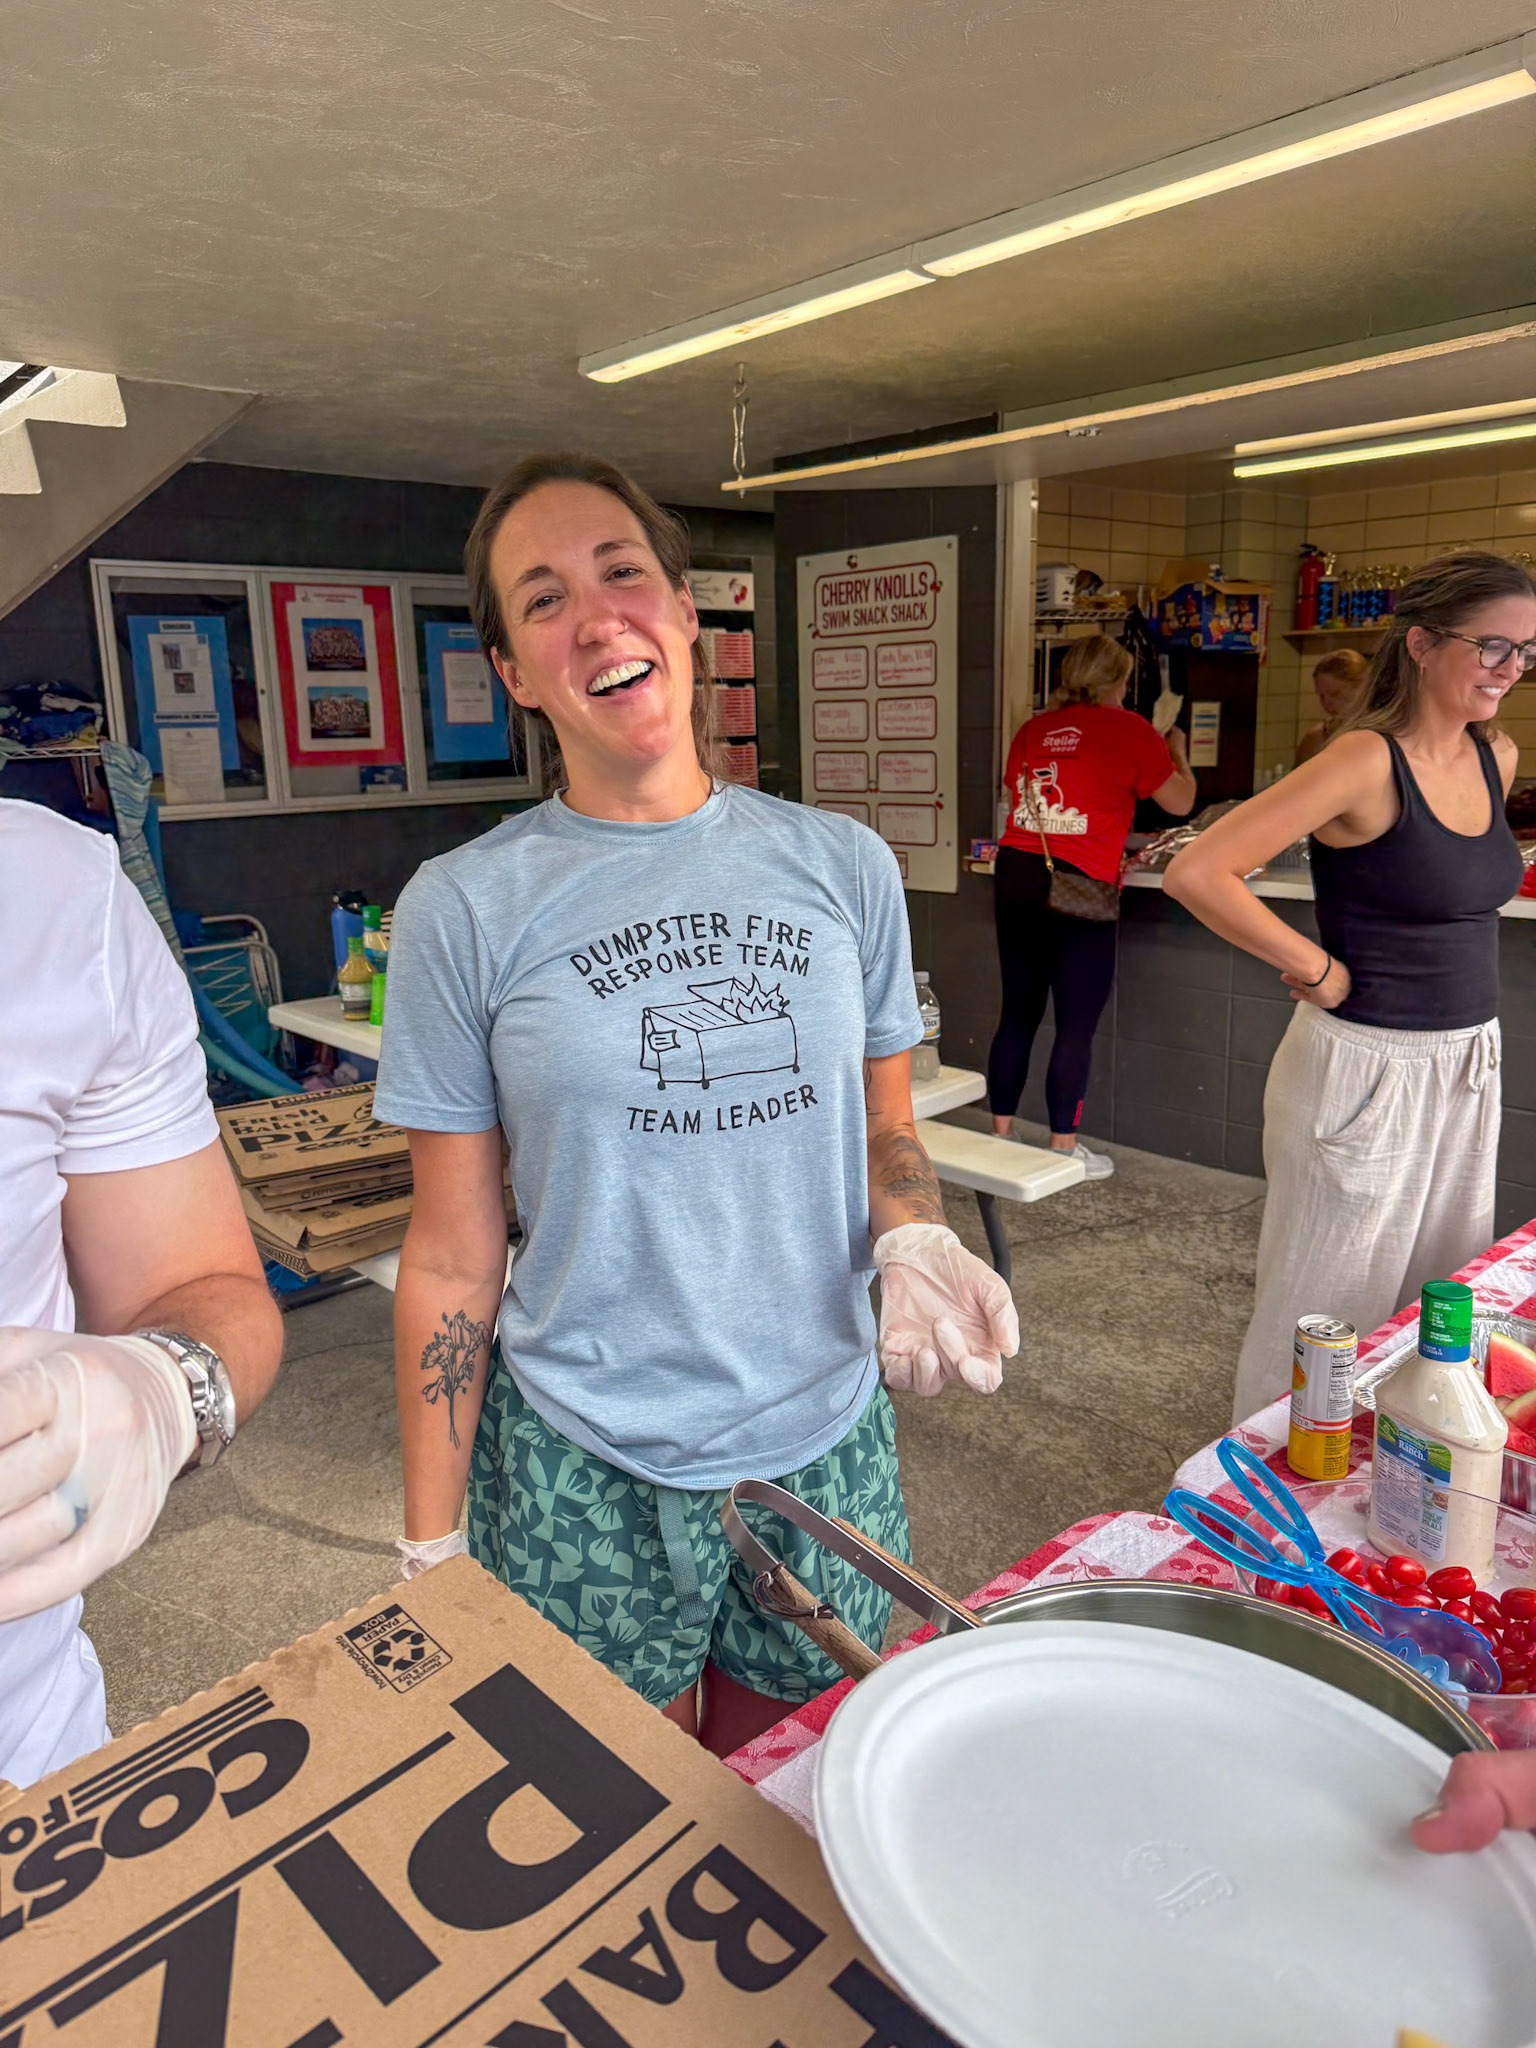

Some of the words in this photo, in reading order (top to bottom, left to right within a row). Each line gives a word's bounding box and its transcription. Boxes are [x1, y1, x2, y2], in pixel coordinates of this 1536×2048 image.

[821, 578, 871, 608] CHERRY
[874, 571, 928, 602] KNOLLS
[822, 609, 850, 629] SWIM
[853, 605, 888, 627] SNACK
[891, 602, 928, 623] SHACK
[1028, 818, 1086, 833] NPTUNES
[569, 912, 731, 978] DUMPSTER
[746, 914, 813, 951] FIRE
[588, 944, 723, 1000] RESPONSE
[737, 944, 811, 977] TEAM
[626, 1106, 701, 1135] TEAM
[716, 1084, 819, 1132] LEADER
[239, 1118, 396, 1153] PIZZ
[361, 1614, 387, 1631] BOX
[362, 1618, 400, 1642] PAPER
[398, 1672, 415, 1683] Dry
[411, 1661, 442, 1681] Recycle
[418, 1655, 441, 1670] Clean
[0, 1794, 71, 1855] FO
[0, 1717, 310, 1942] COS
[0, 1662, 672, 2048] PIZ
[484, 1844, 827, 2048] BAK
